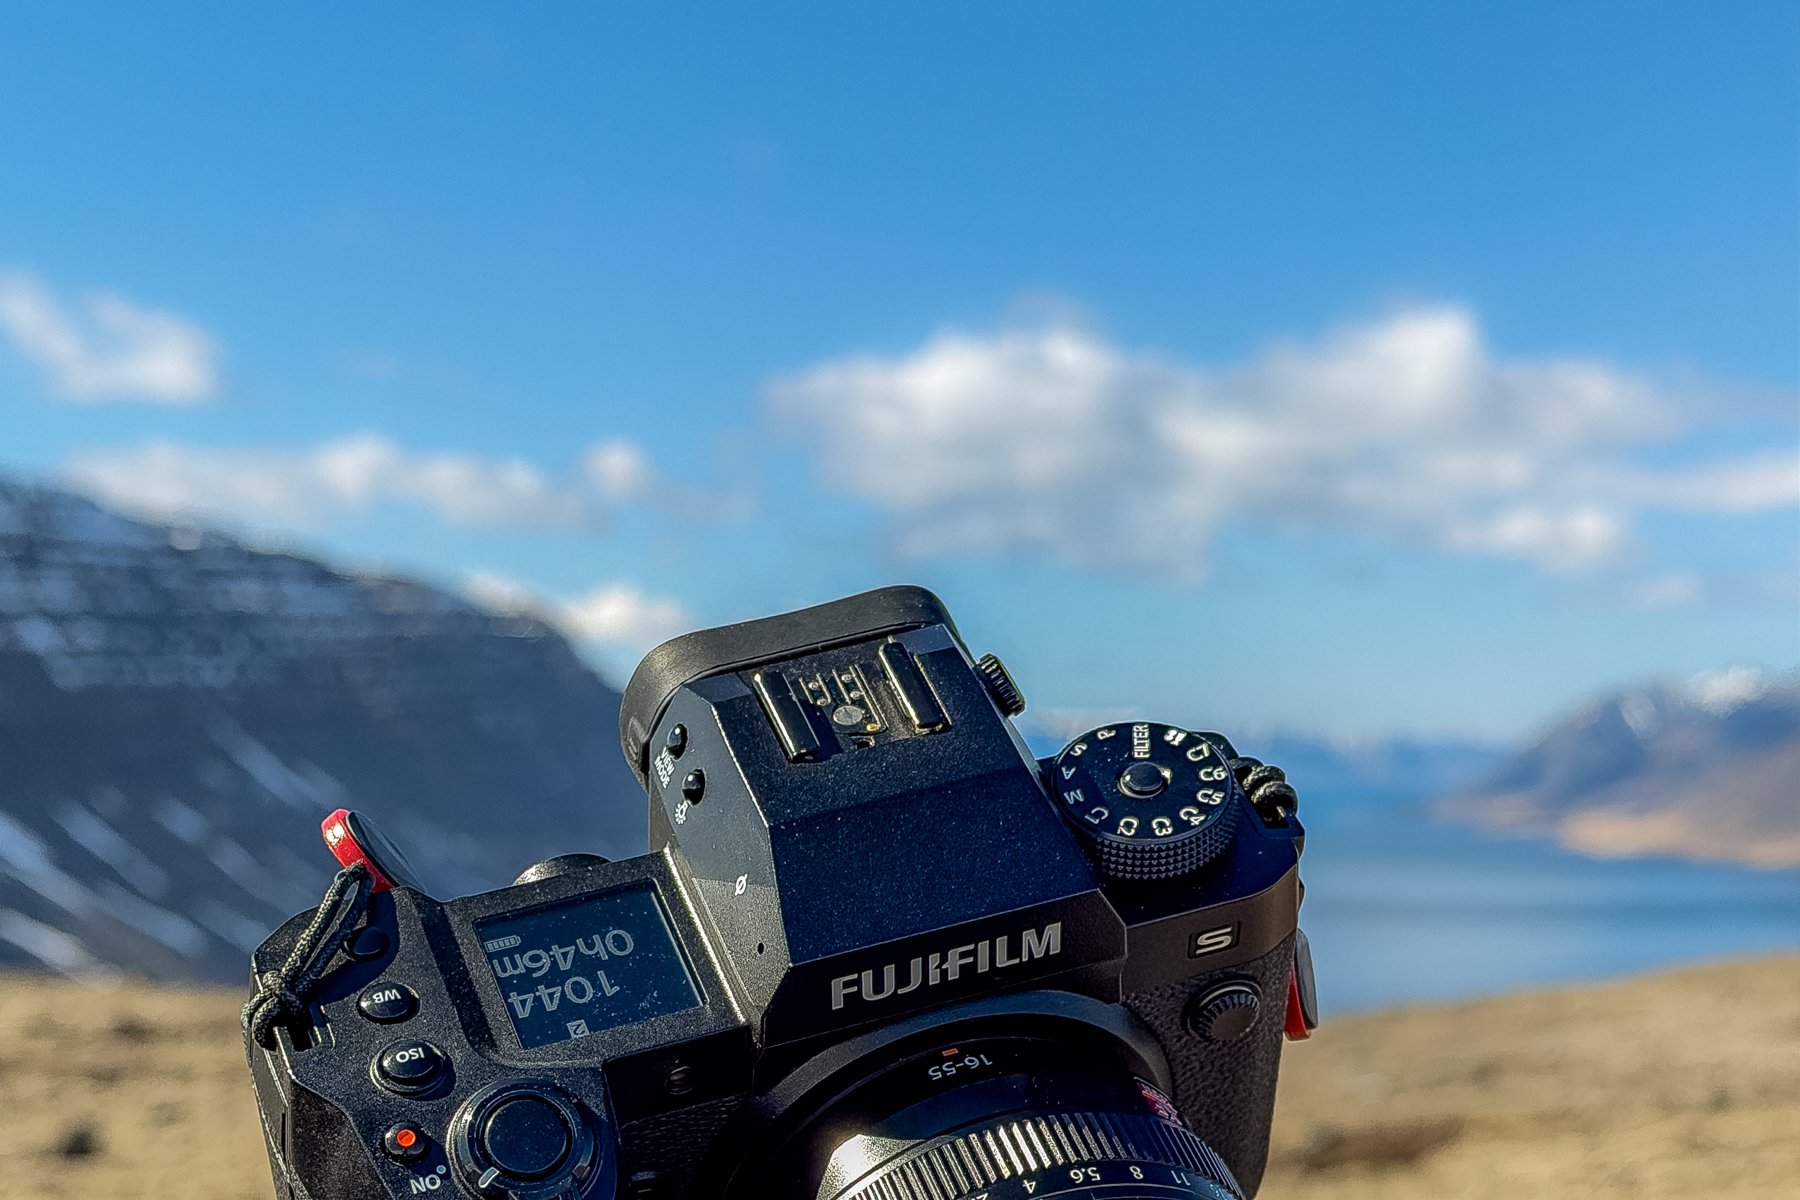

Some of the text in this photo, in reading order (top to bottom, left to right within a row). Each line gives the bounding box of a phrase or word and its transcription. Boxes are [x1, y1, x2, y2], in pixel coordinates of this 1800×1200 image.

[1097, 729, 1116, 740] P
[1133, 724, 1150, 758] FILTER
[1070, 743, 1088, 756] S
[1186, 743, 1210, 761] C7
[661, 746, 675, 776] VIEW
[654, 755, 670, 789] MODE
[1062, 766, 1076, 780] A
[1199, 766, 1227, 781] C6
[1064, 789, 1084, 805] M
[1196, 788, 1225, 805] C5
[1084, 807, 1109, 825] C1
[1117, 816, 1139, 836] C2
[1179, 806, 1206, 826] C4
[1151, 817, 1173, 836] C3
[1195, 926, 1233, 955] S
[492, 929, 634, 978] 0h46m
[831, 921, 1062, 1011] FUJIFILM
[372, 989, 401, 1004] WB
[508, 970, 620, 1019] 1044
[395, 1047, 425, 1063] ISO
[927, 1053, 993, 1081] 16-55
[410, 1173, 441, 1195] ON
[1022, 1179, 1037, 1194] 4
[1069, 1166, 1101, 1184] 5.6
[1129, 1165, 1144, 1180] 8
[1170, 1170, 1192, 1186] 11
